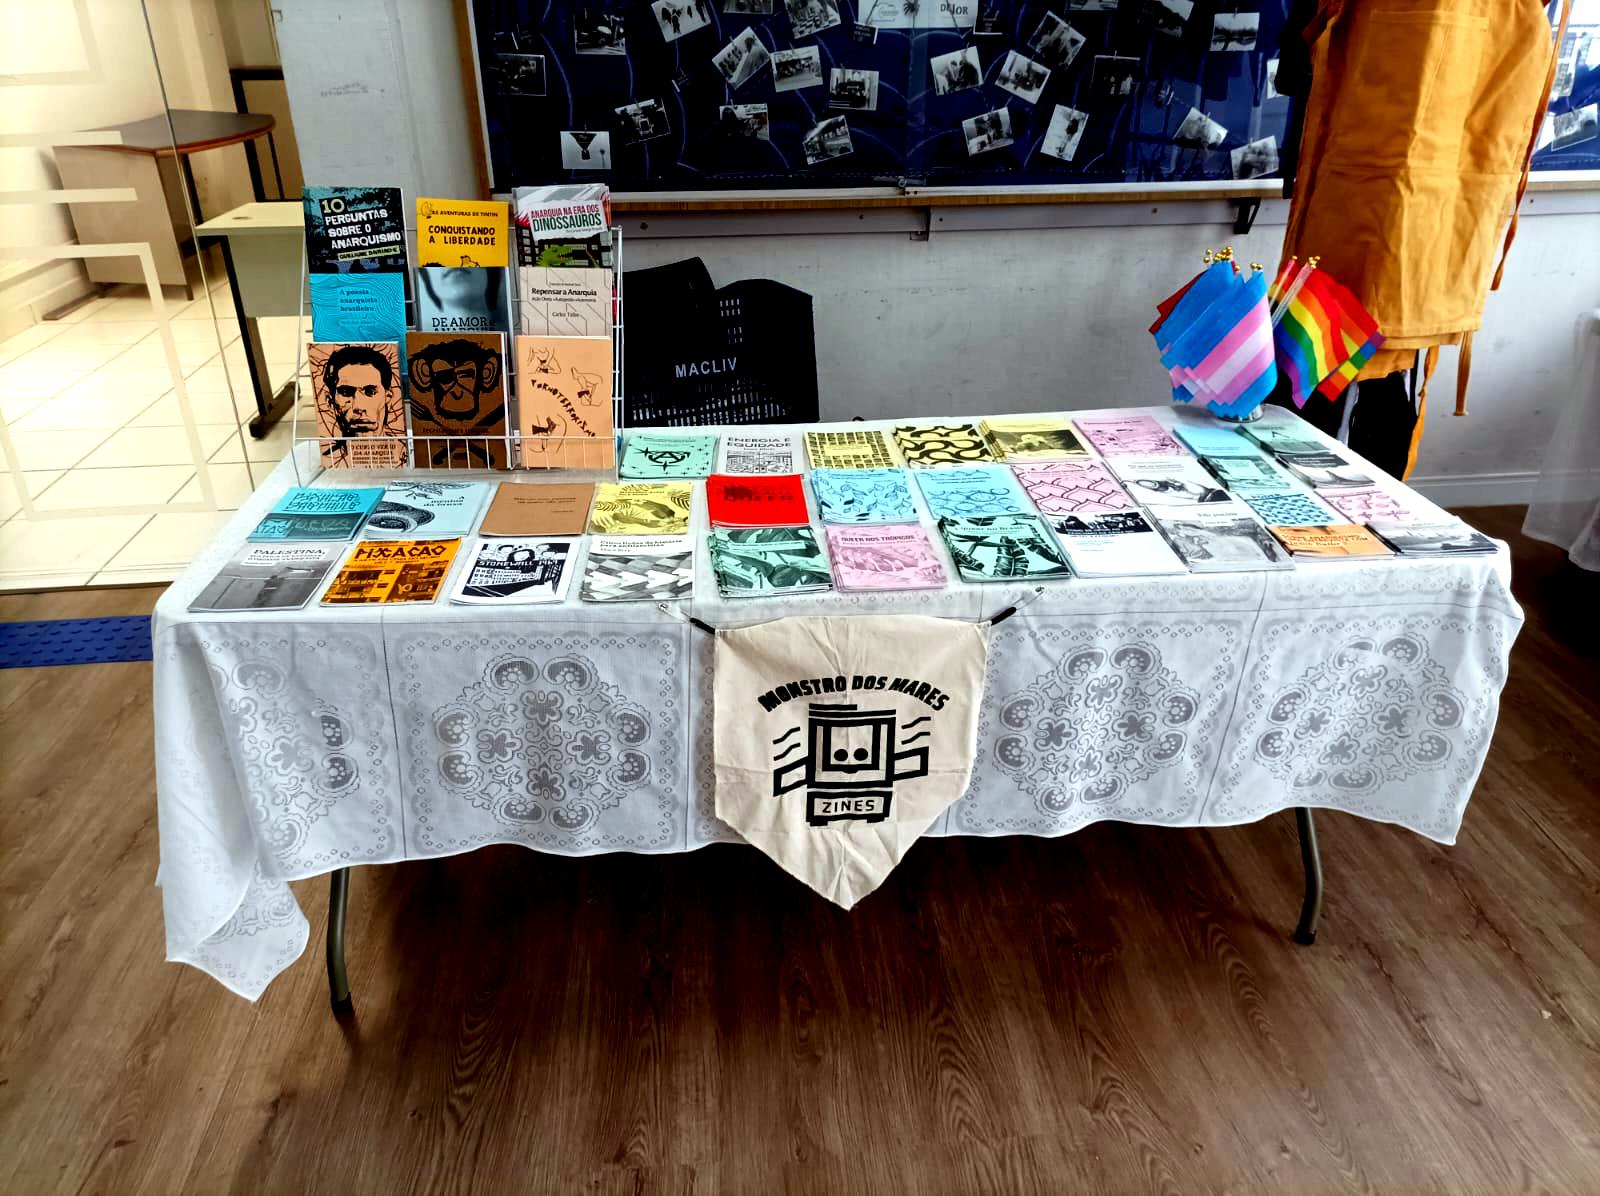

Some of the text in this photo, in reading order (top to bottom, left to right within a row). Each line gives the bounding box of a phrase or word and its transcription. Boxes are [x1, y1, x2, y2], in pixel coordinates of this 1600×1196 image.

[321, 199, 345, 214] 10
[531, 204, 599, 218] ANARQUIA NA ERA DOS
[325, 209, 388, 226] PERGUNTAS
[533, 213, 602, 232] DINOSSAUROS
[328, 223, 372, 237] SOBRE O
[429, 225, 496, 235] CONQUISTANDO
[331, 231, 401, 249] ANARQUISMO
[429, 236, 496, 246] A LIBERDADE
[432, 318, 447, 327] DE
[450, 317, 487, 327] AMOR
[675, 357, 737, 378] MACLIV
[758, 676, 950, 712] MONSTRO DOS MARES
[822, 800, 875, 813] ZINES
